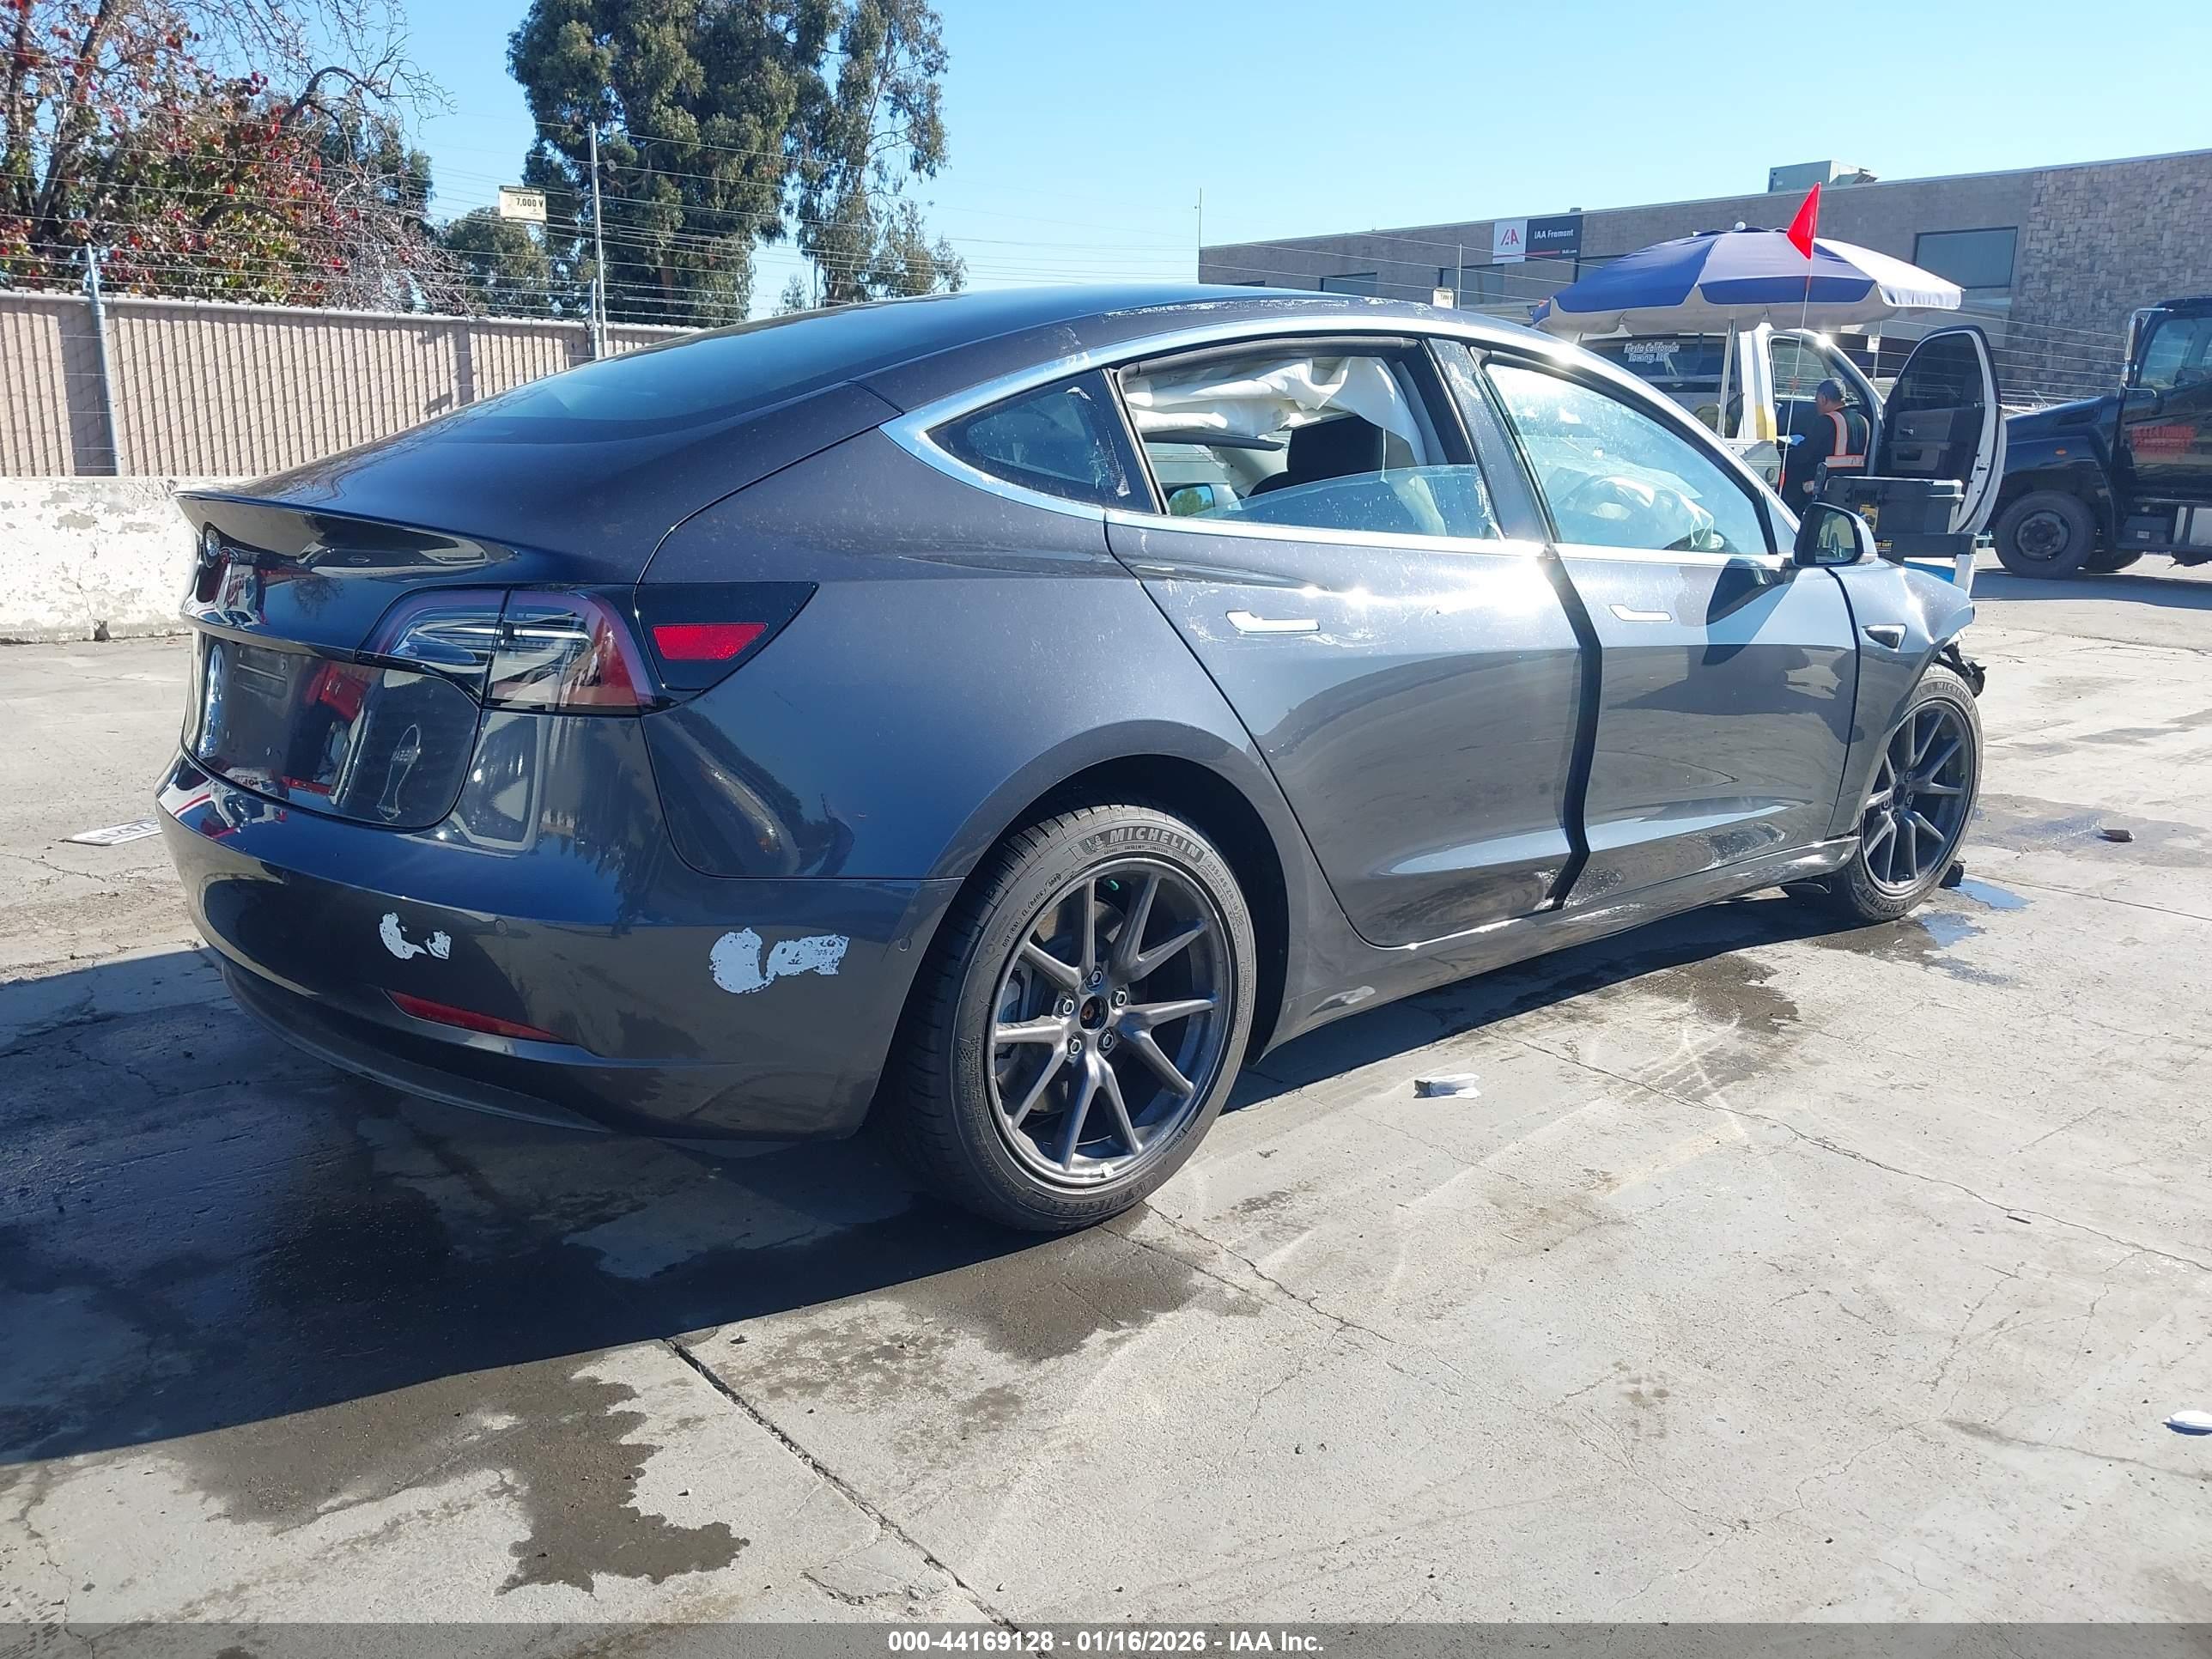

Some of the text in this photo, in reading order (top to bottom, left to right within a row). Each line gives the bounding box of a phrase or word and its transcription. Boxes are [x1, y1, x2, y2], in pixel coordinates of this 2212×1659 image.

[538, 199, 544, 208] V
[1534, 228, 1574, 239] IAA Fremont
[1624, 341, 1680, 354] Fiesta California
[1628, 353, 1655, 364] Towing
[1936, 682, 1972, 709] MICHELIN
[1109, 827, 1200, 858] MICHELIN
